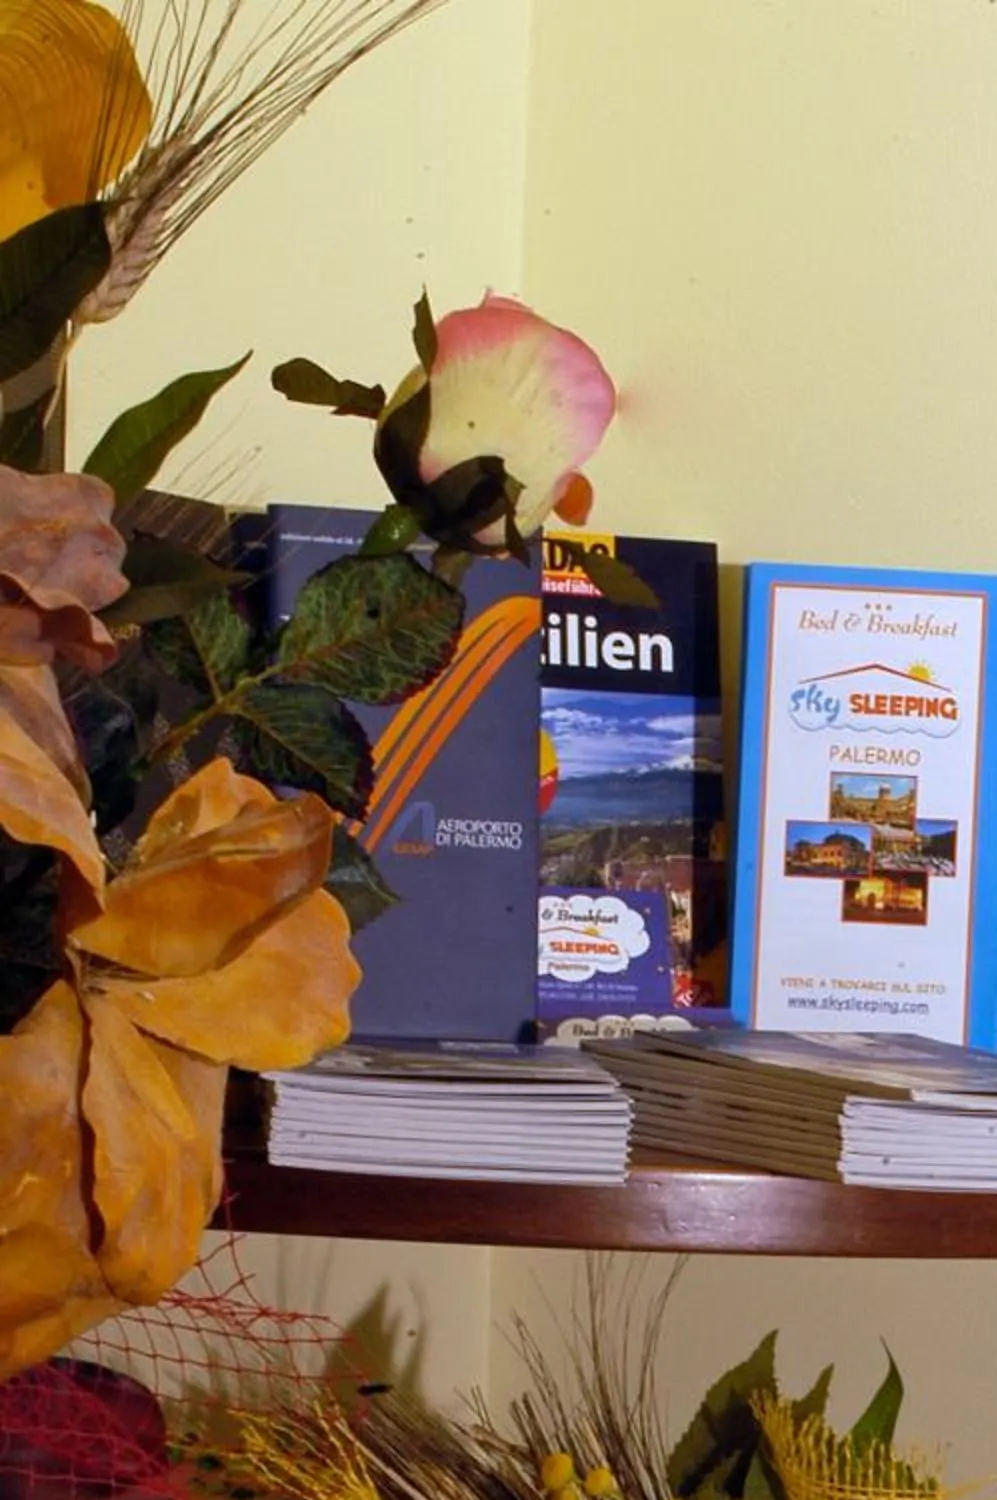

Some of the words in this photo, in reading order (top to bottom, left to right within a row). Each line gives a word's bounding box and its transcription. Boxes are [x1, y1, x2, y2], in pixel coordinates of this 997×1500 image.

[799, 610, 838, 631] Bed
[843, 612, 862, 632] &
[867, 613, 958, 640] Breakfast
[540, 613, 674, 672] ilien
[849, 693, 958, 720] SLEEPING
[830, 745, 921, 767] PALERMO
[437, 819, 522, 834] AEROPORTO
[436, 832, 450, 846] DI
[454, 833, 522, 849] PALERMO
[557, 909, 619, 925] Breakfast
[550, 941, 619, 956] SLEEPING
[788, 996, 930, 1015] www.skysleeping.com
